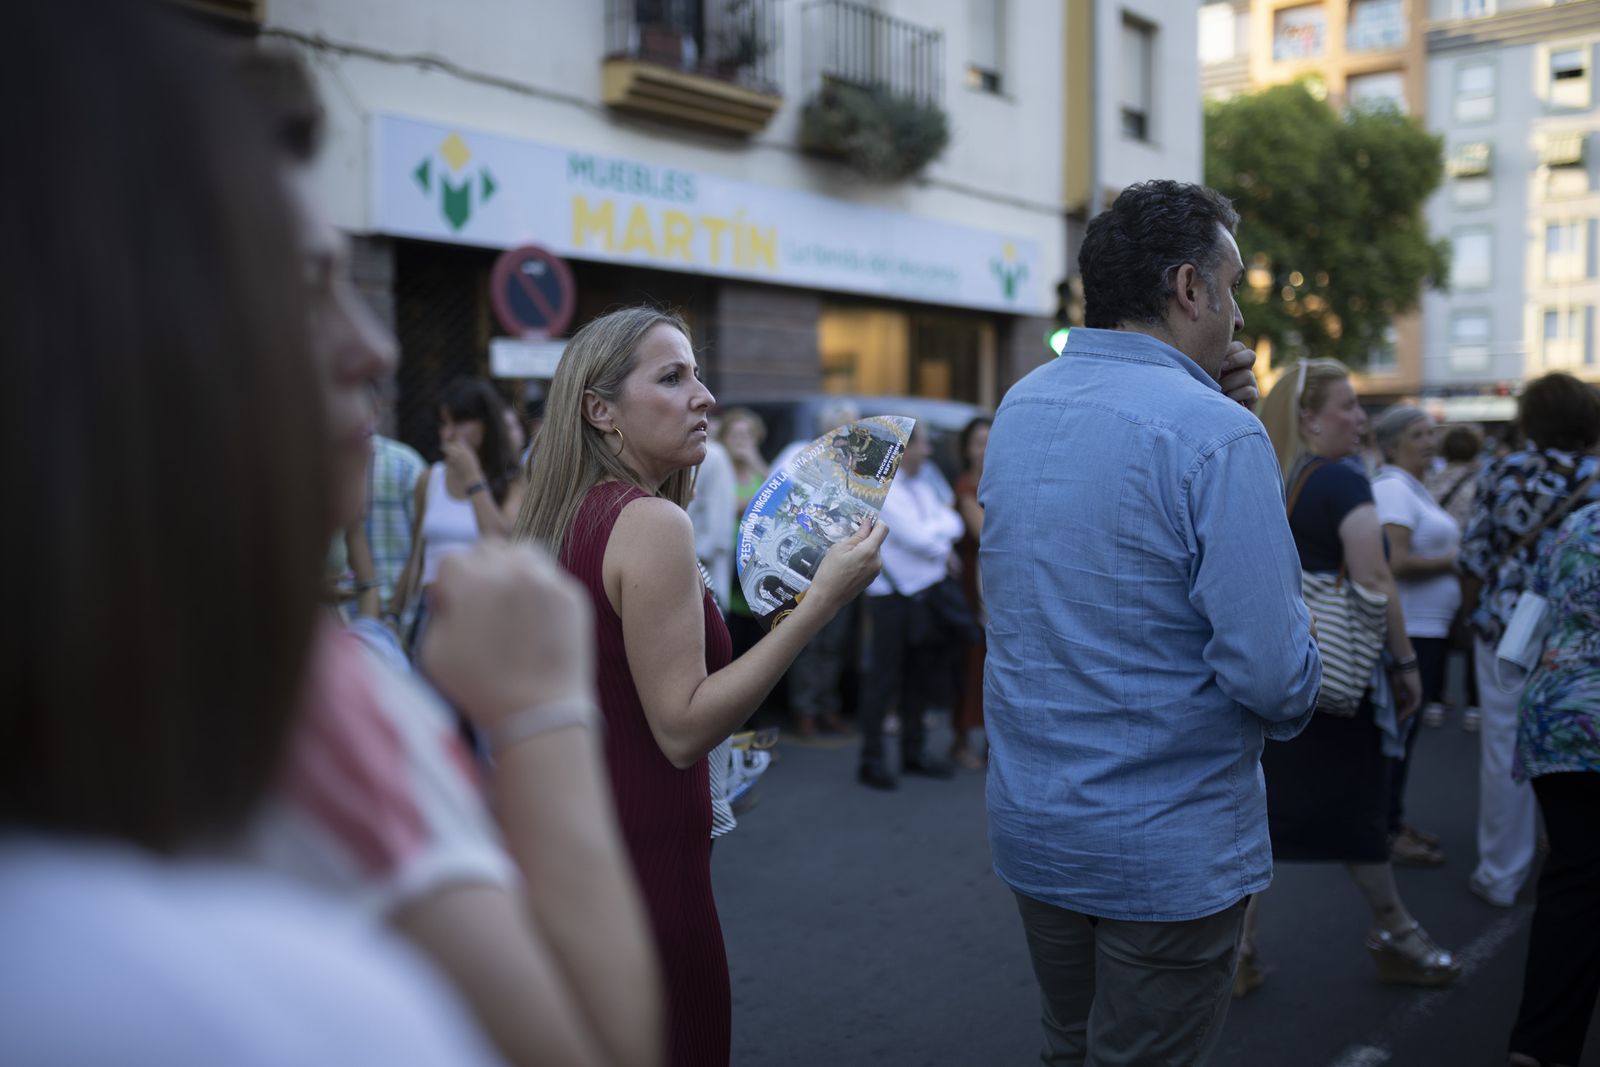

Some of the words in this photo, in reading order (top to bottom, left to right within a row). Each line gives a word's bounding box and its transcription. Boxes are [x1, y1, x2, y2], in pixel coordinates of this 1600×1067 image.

[567, 152, 697, 203] MUEBLES
[572, 194, 777, 273] MARTÍN
[741, 512, 759, 557] FESTIVIDAD
[751, 487, 774, 513] VIRGEN
[768, 478, 782, 490] DE
[777, 471, 789, 482] LA
[806, 443, 825, 460] 2022
